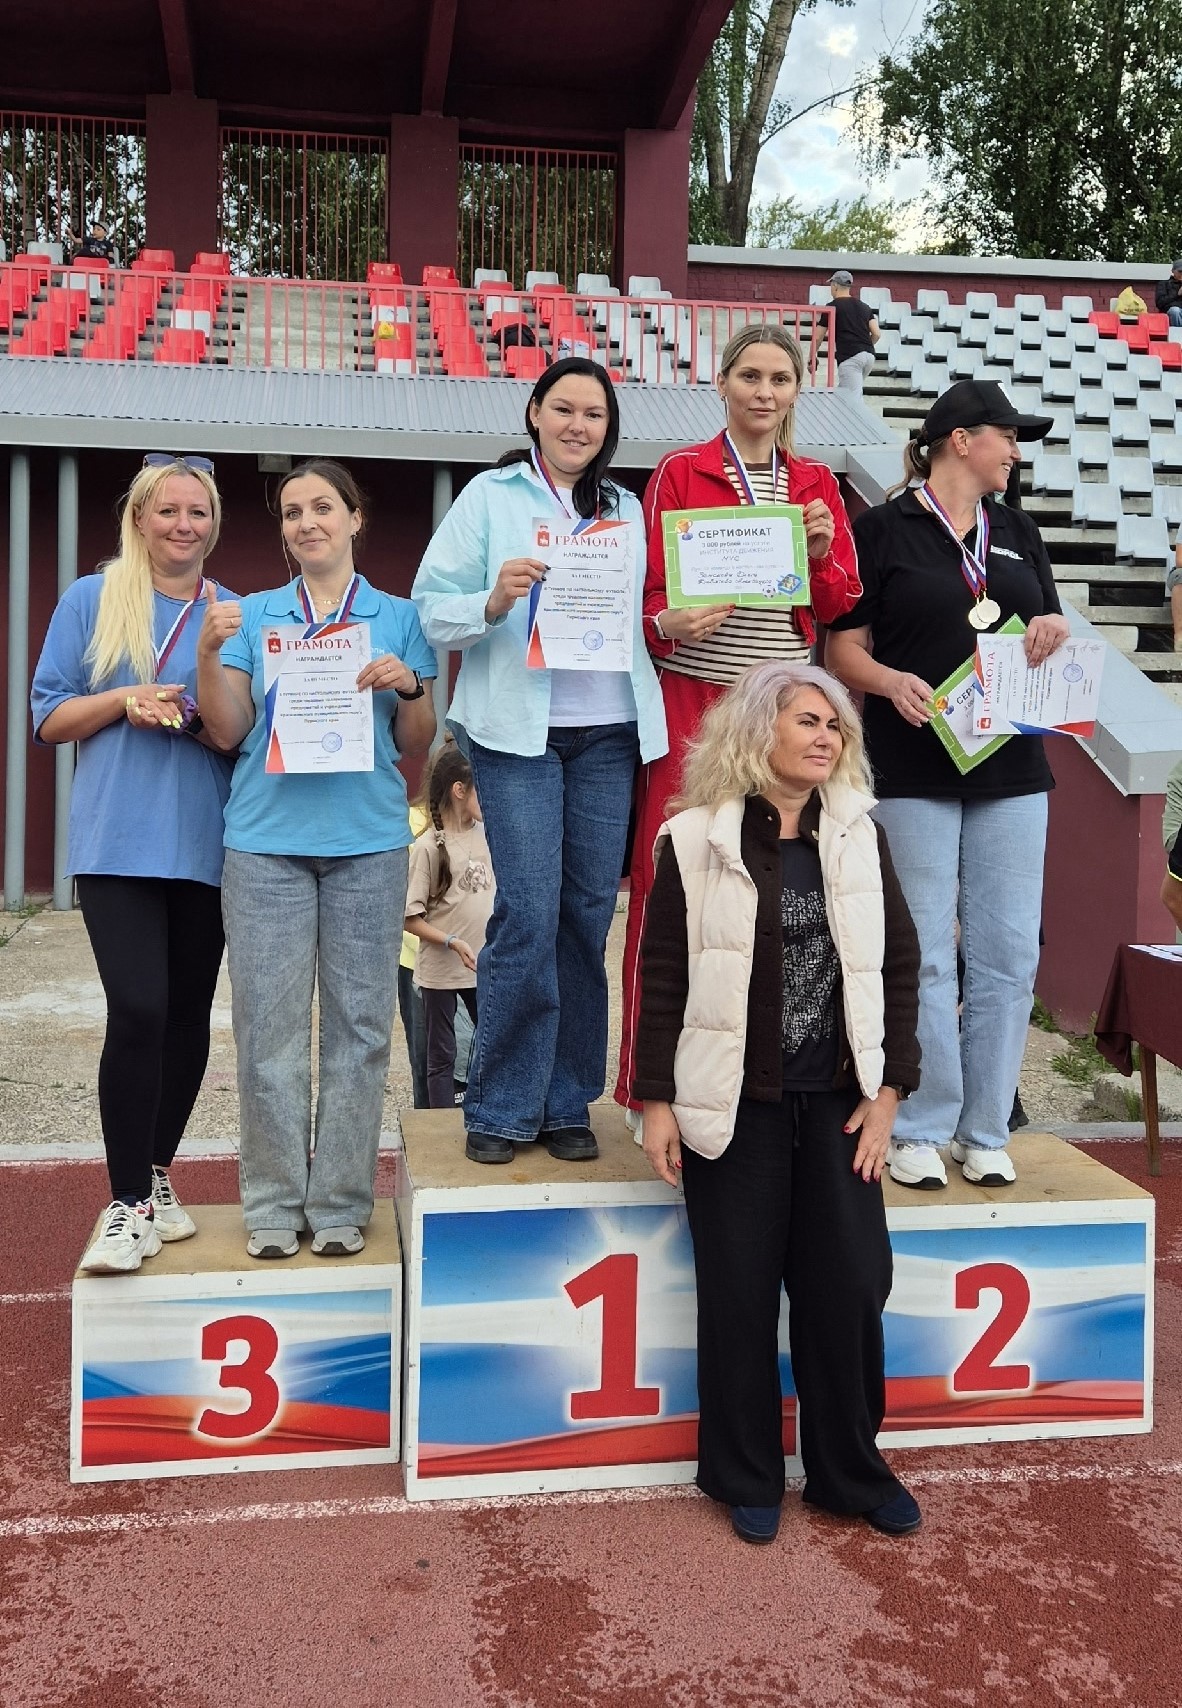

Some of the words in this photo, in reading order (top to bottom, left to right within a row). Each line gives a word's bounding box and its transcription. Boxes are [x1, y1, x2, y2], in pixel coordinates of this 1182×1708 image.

[555, 535, 618, 548] ГРАМОТА
[698, 527, 772, 539] СЕРТИФИКАТ
[286, 638, 352, 651] ГРАМОТА
[983, 651, 996, 712] ГРАМОТА
[564, 1253, 660, 1420] 1
[953, 1262, 1031, 1392] 2
[197, 1314, 280, 1439] 3
